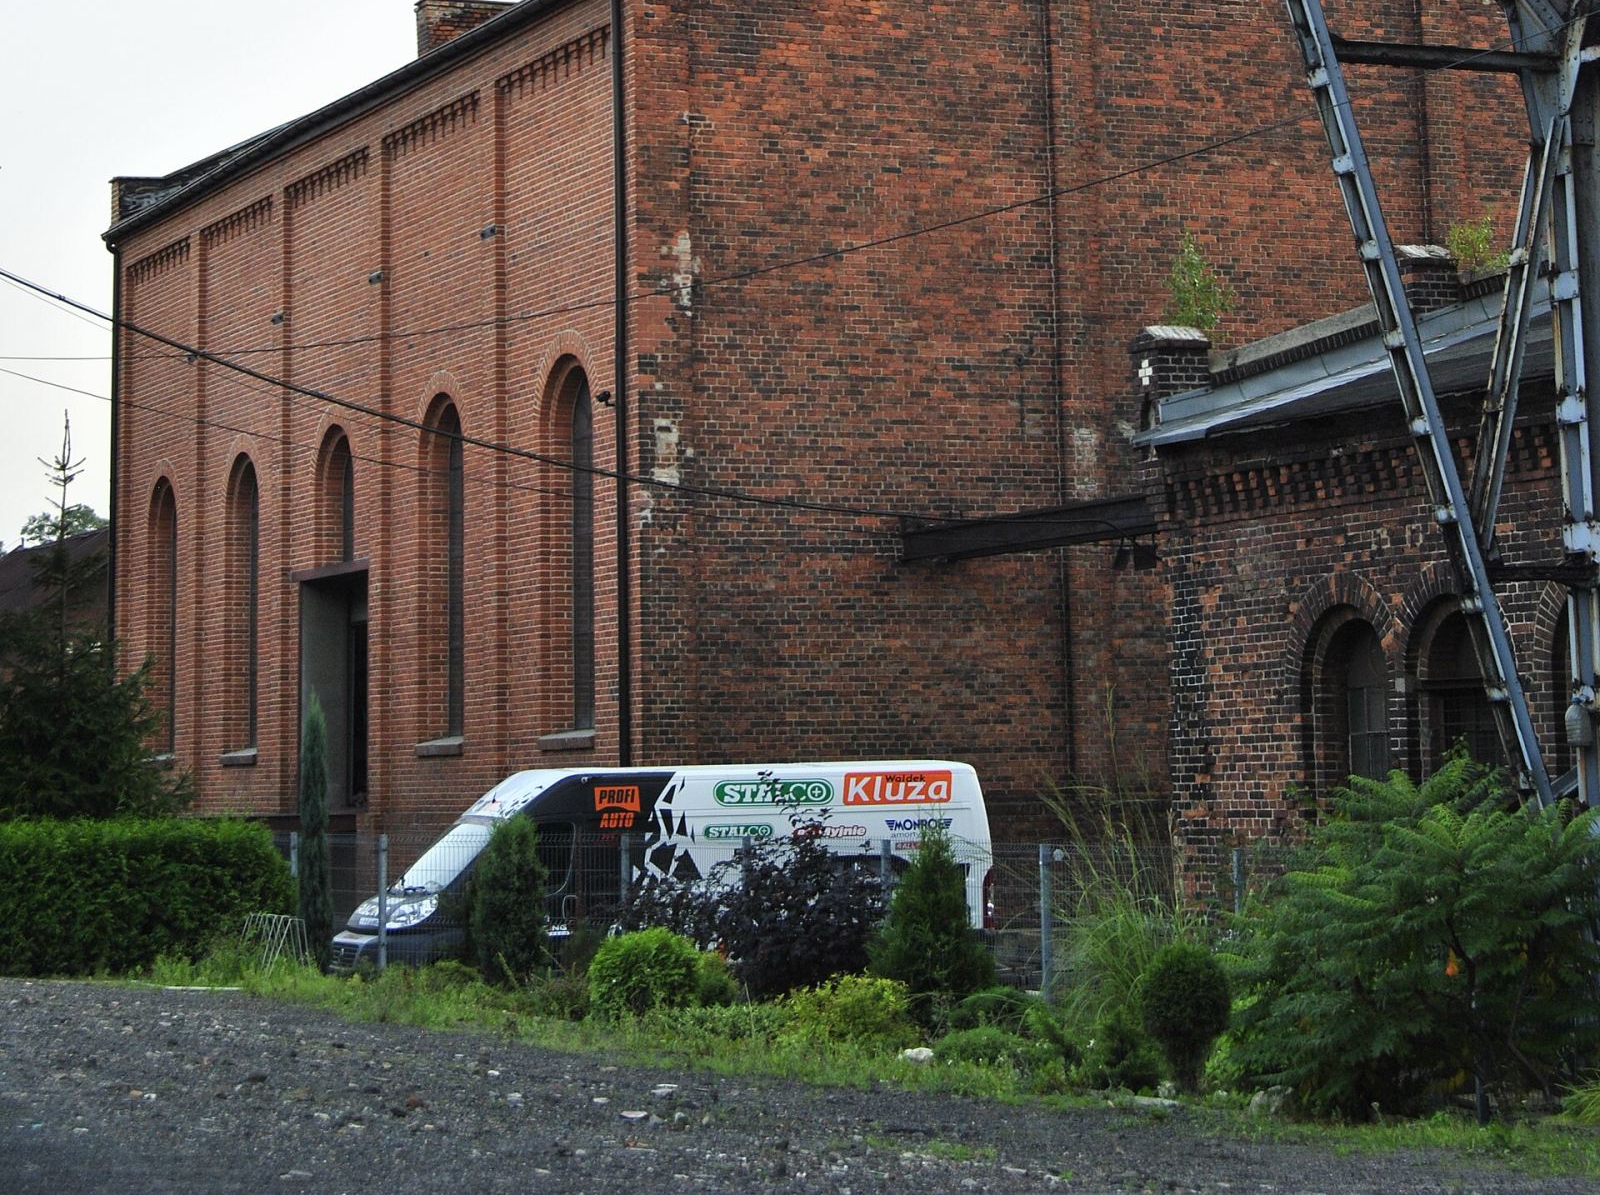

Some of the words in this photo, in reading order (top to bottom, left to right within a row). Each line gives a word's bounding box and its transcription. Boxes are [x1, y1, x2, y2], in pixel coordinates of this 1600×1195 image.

[885, 774, 926, 783] Waldek
[598, 788, 635, 804] PROFI
[723, 782, 827, 803] STALCO
[847, 775, 949, 802] Kluza
[600, 812, 635, 828] AUTO
[709, 825, 771, 838] STALCO
